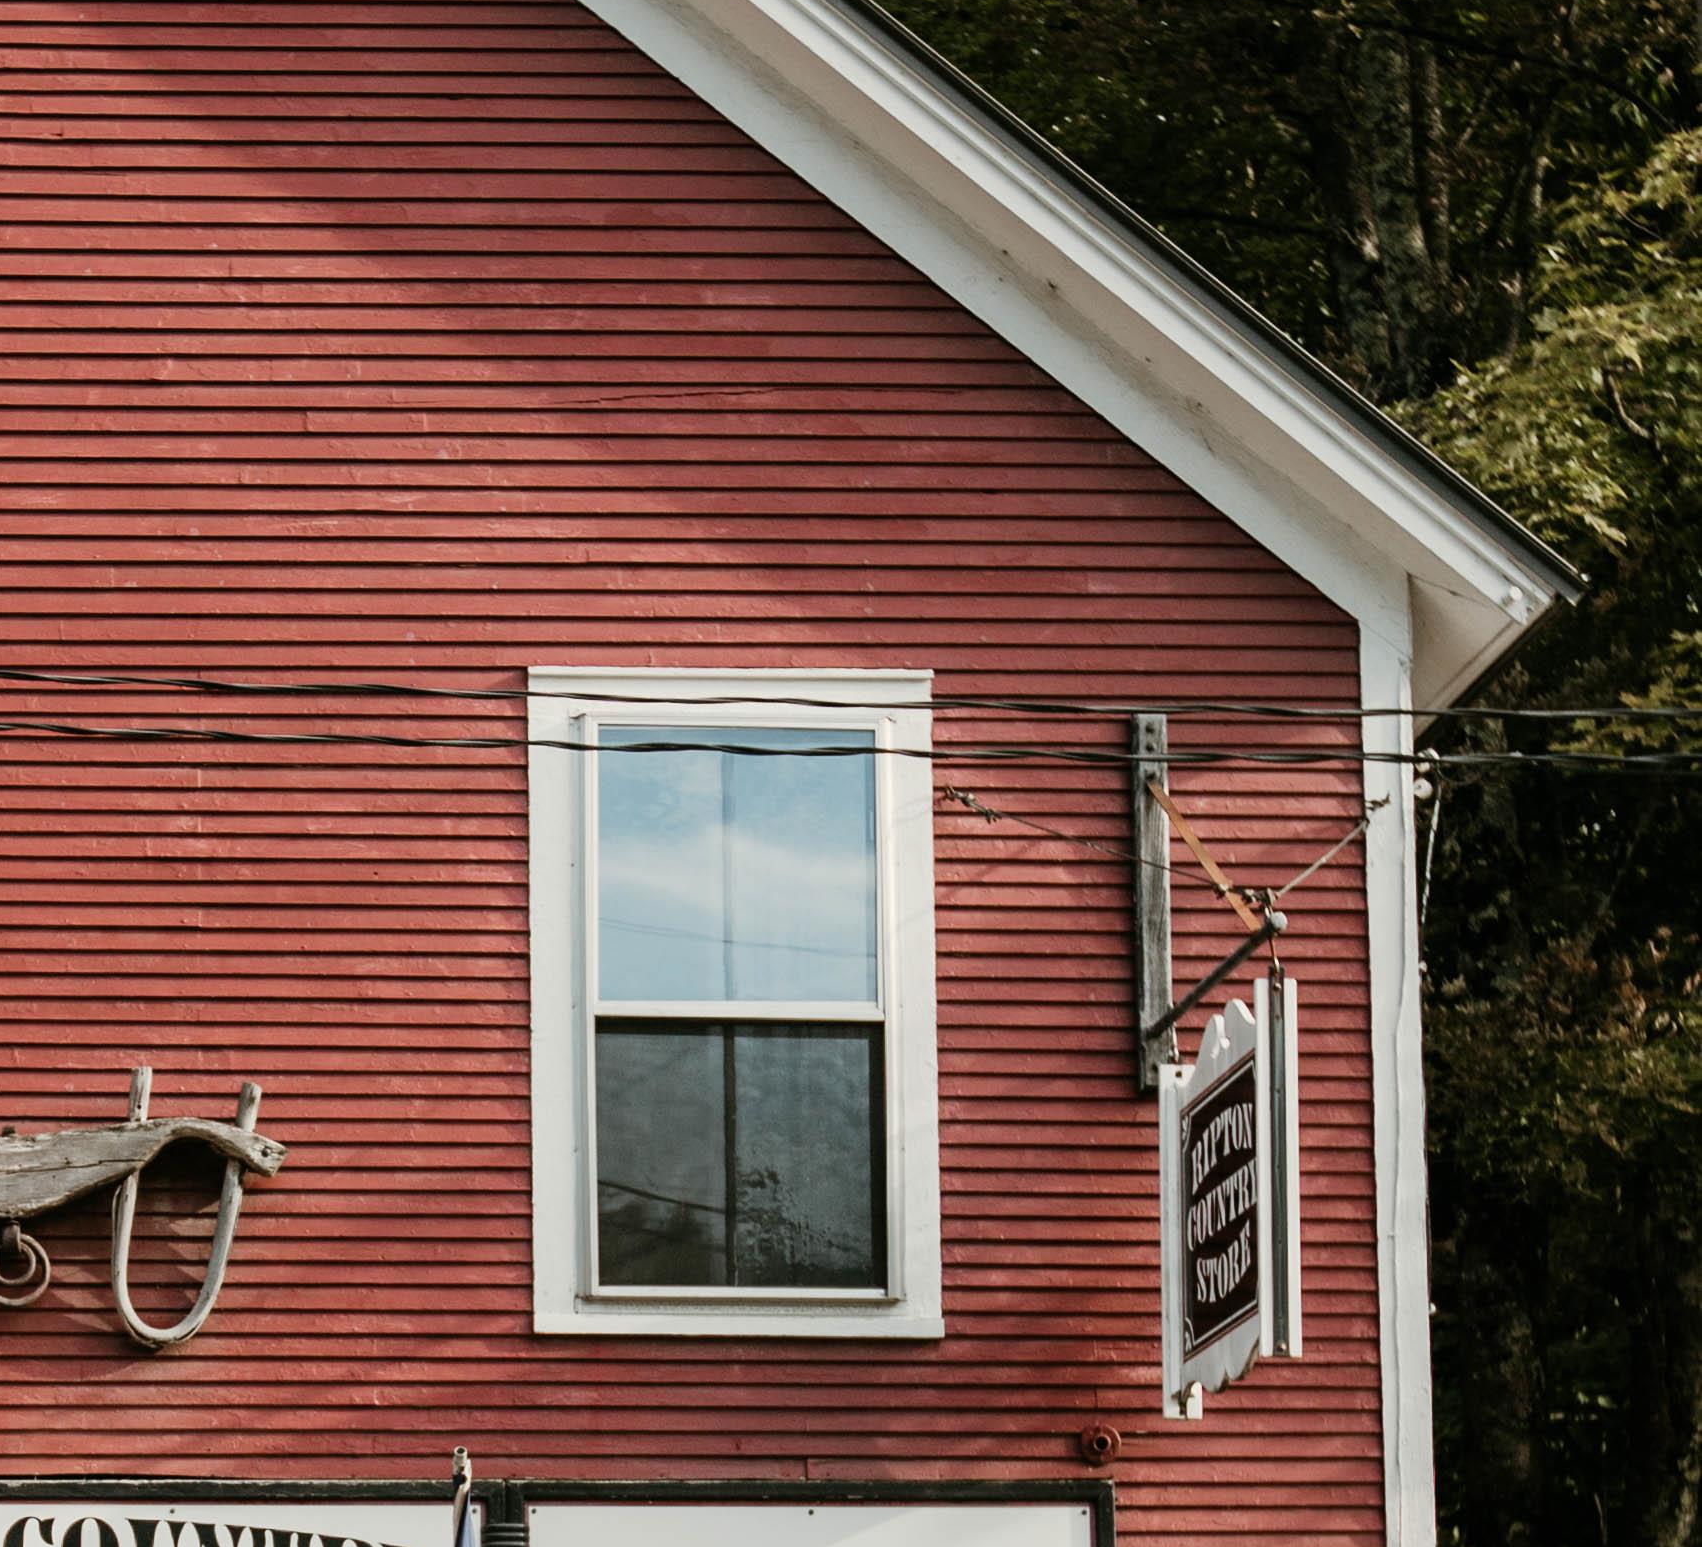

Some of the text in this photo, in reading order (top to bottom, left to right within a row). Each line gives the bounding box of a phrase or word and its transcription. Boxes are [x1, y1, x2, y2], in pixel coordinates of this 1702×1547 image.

[1192, 1103, 1253, 1196] RIPTON
[1187, 1157, 1258, 1251] COUNTRY
[1197, 1220, 1251, 1303] STORE
